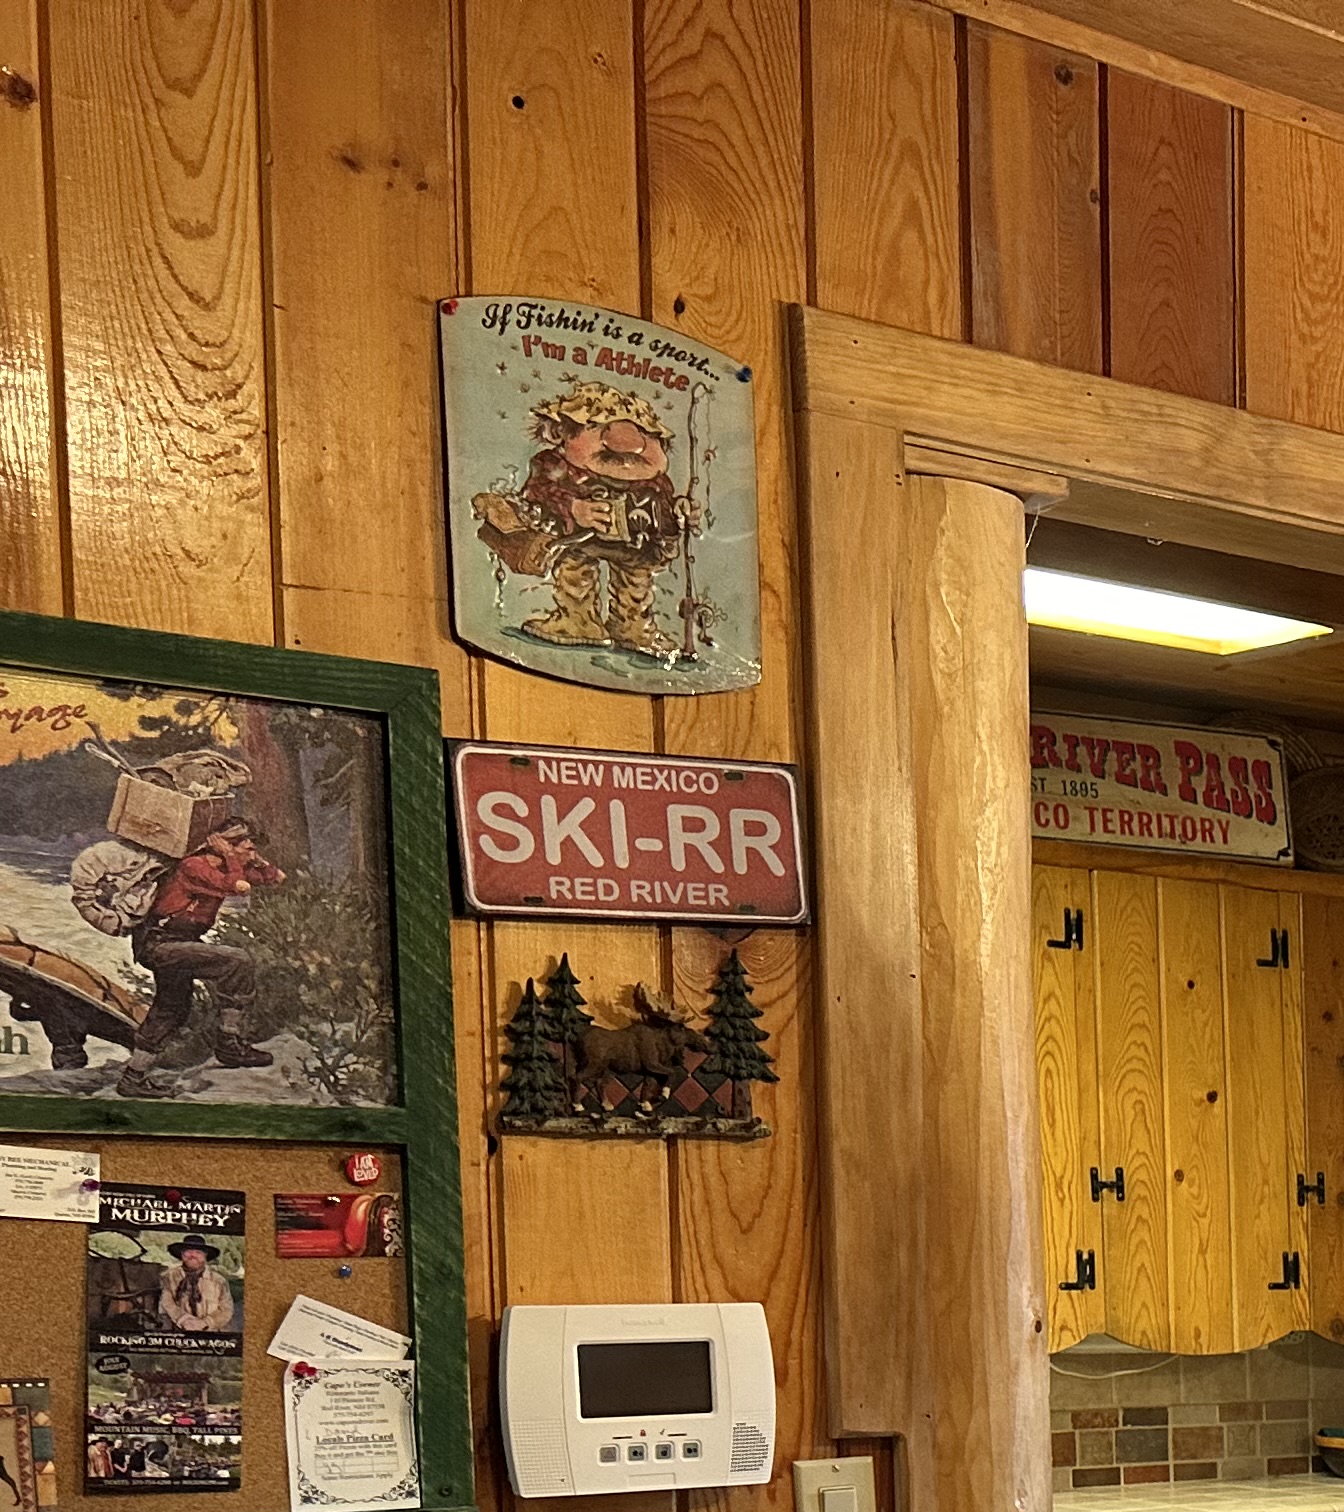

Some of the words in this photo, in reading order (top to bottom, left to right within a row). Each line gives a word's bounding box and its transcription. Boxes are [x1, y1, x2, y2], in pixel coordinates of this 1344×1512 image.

[481, 303, 512, 336] If
[516, 302, 600, 333] Fishin'
[602, 319, 623, 339] is
[628, 331, 645, 346] a
[521, 334, 566, 361] I'm
[572, 348, 588, 366] a
[595, 347, 690, 392] Athlete
[0, 704, 88, 734] yage
[537, 760, 604, 787] NEW
[612, 765, 719, 795] MEXICO
[1030, 725, 1168, 797] RIVER
[1173, 740, 1278, 826] PASS
[1061, 780, 1099, 799] 1895
[476, 791, 786, 877] SKI-RR
[1084, 805, 1231, 845] TERRITORY
[549, 876, 620, 901] RED
[630, 880, 730, 907] RIVER
[100, 1196, 173, 1210] MICHAEL
[178, 1200, 242, 1215] MARTIN
[111, 1208, 230, 1229] MURPHEY
